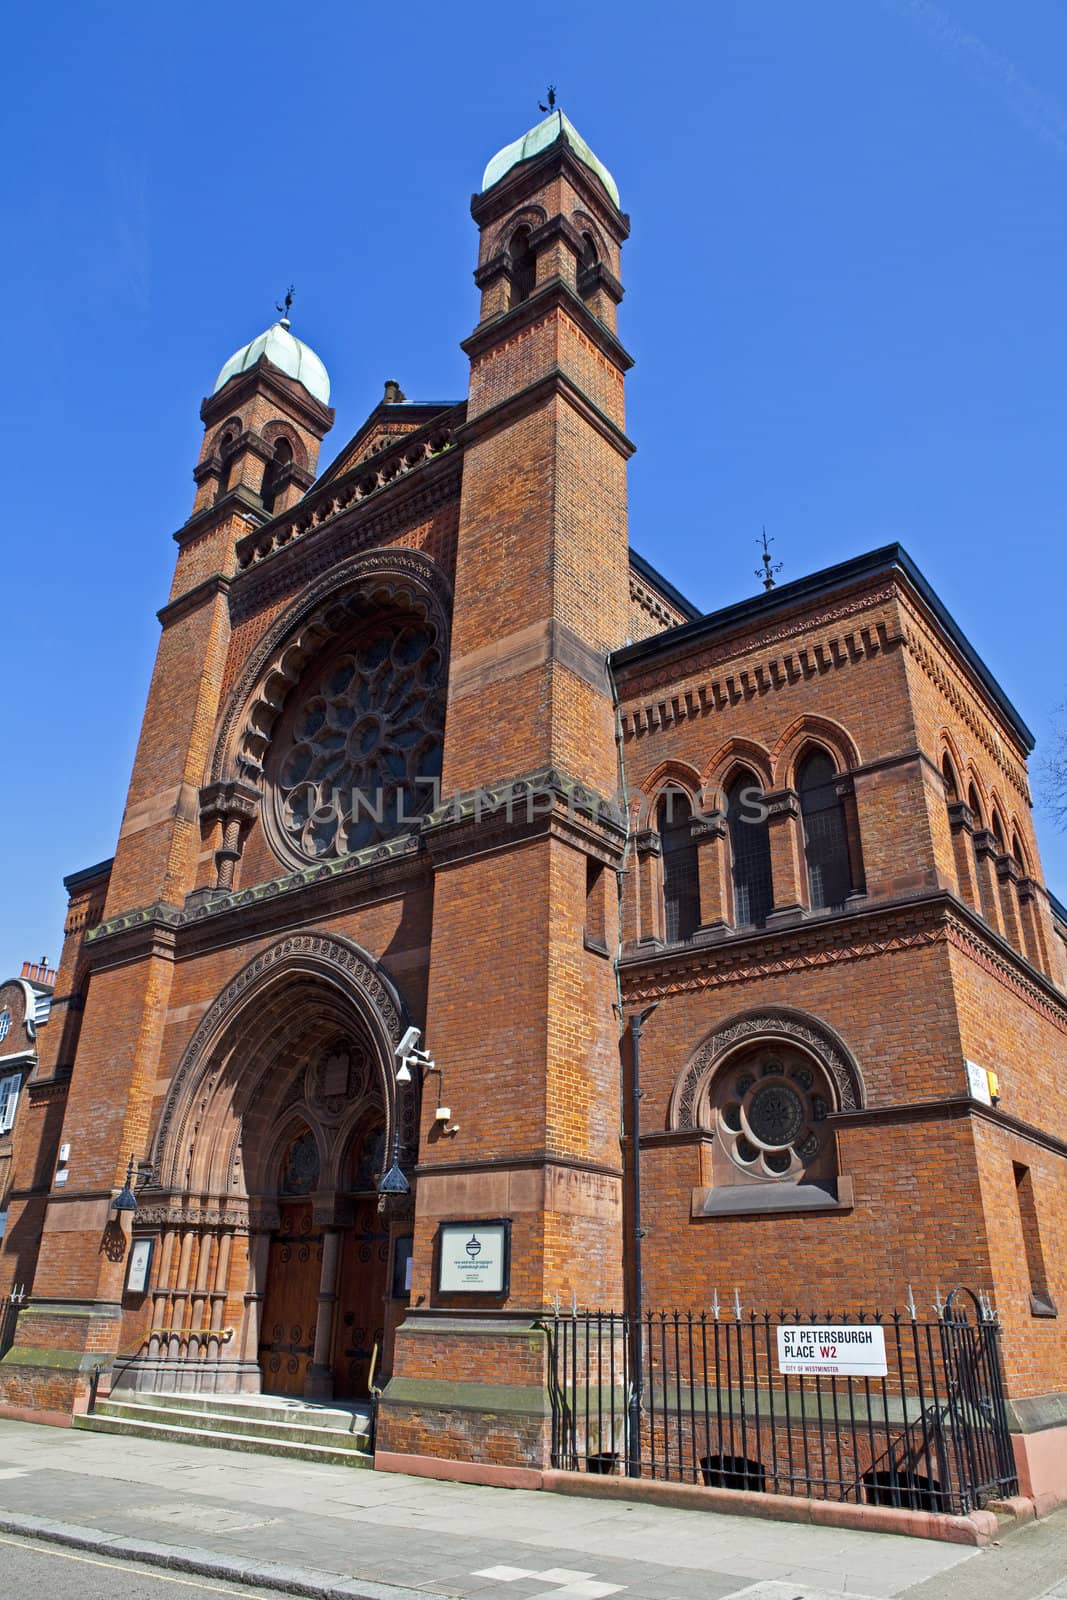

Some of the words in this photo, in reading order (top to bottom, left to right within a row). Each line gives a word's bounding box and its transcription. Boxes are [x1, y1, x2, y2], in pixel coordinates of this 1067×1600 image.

[783, 1331, 796, 1343] ST
[800, 1331, 873, 1344] PETERSBURGH
[785, 1346, 815, 1358] PLACE
[819, 1345, 837, 1358] W2
